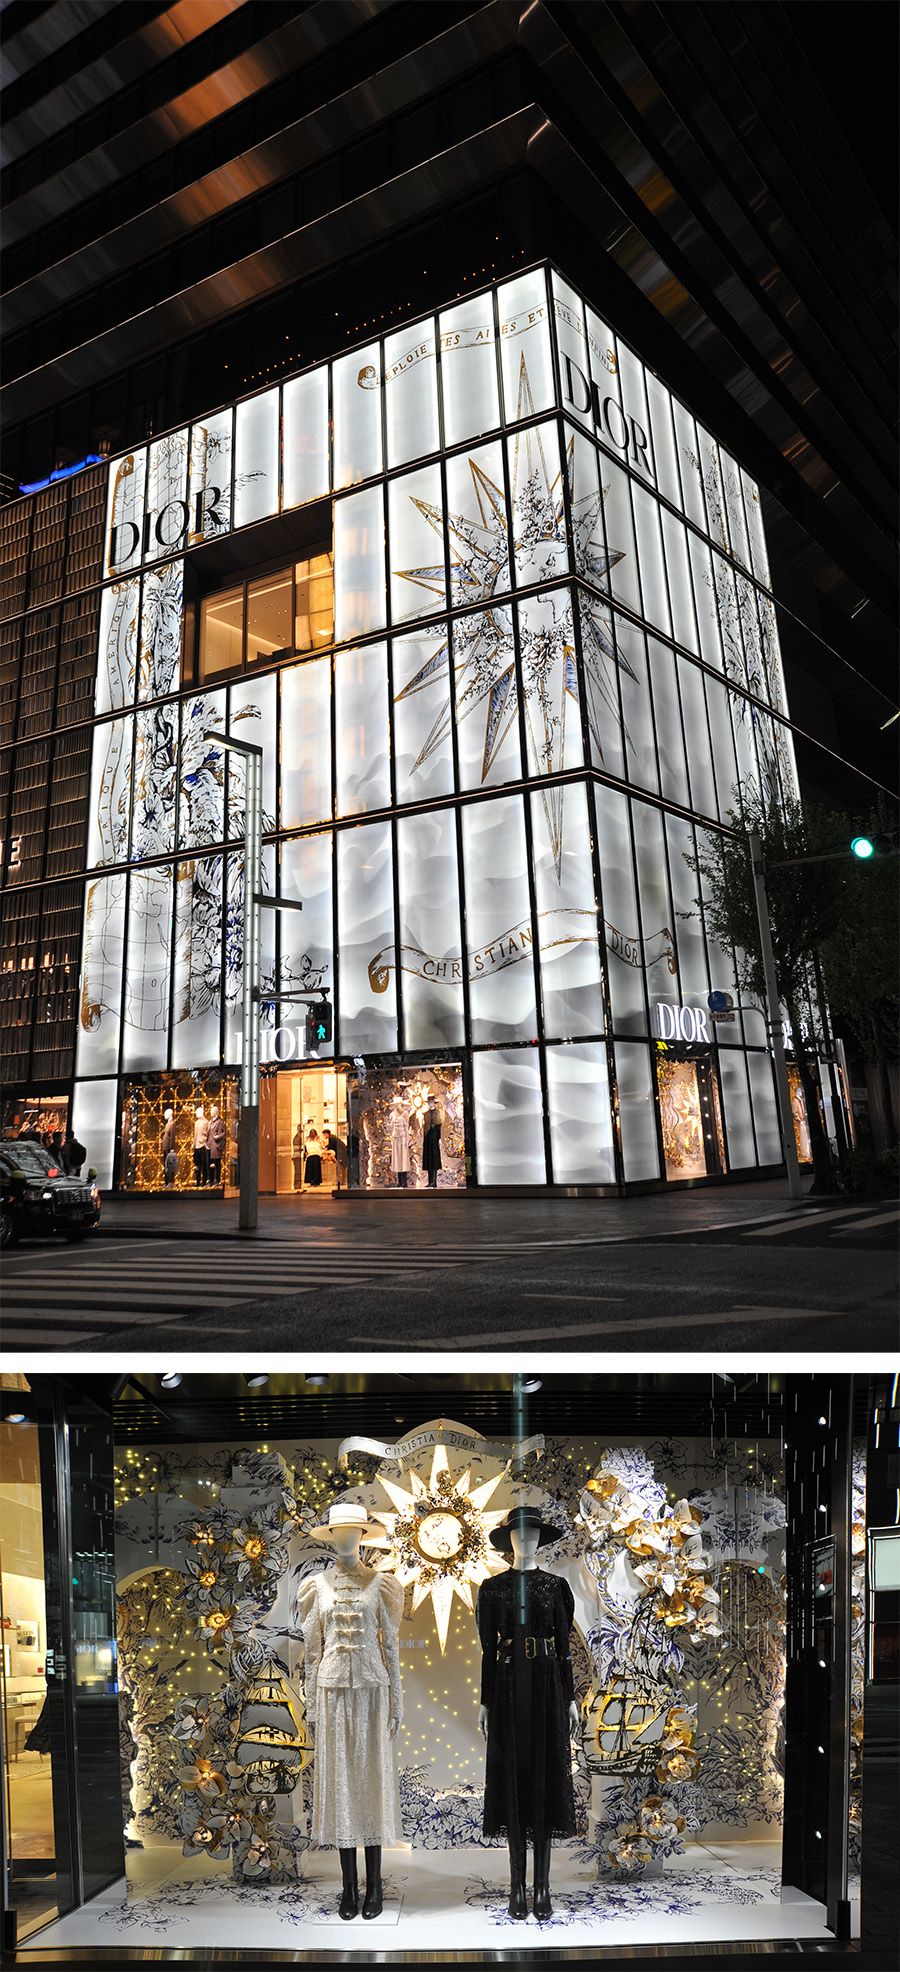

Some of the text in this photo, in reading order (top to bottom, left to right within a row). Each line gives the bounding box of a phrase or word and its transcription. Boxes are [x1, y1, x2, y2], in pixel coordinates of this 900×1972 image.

[475, 321, 517, 341] AIES
[528, 308, 544, 325] ET
[560, 349, 656, 480] DIOR
[106, 486, 225, 569] DIOR
[422, 927, 639, 978] CHRSTIAN DIOR
[657, 1002, 711, 1044] DIOR
[384, 1432, 477, 1457] CHRISTIAN DIOR
